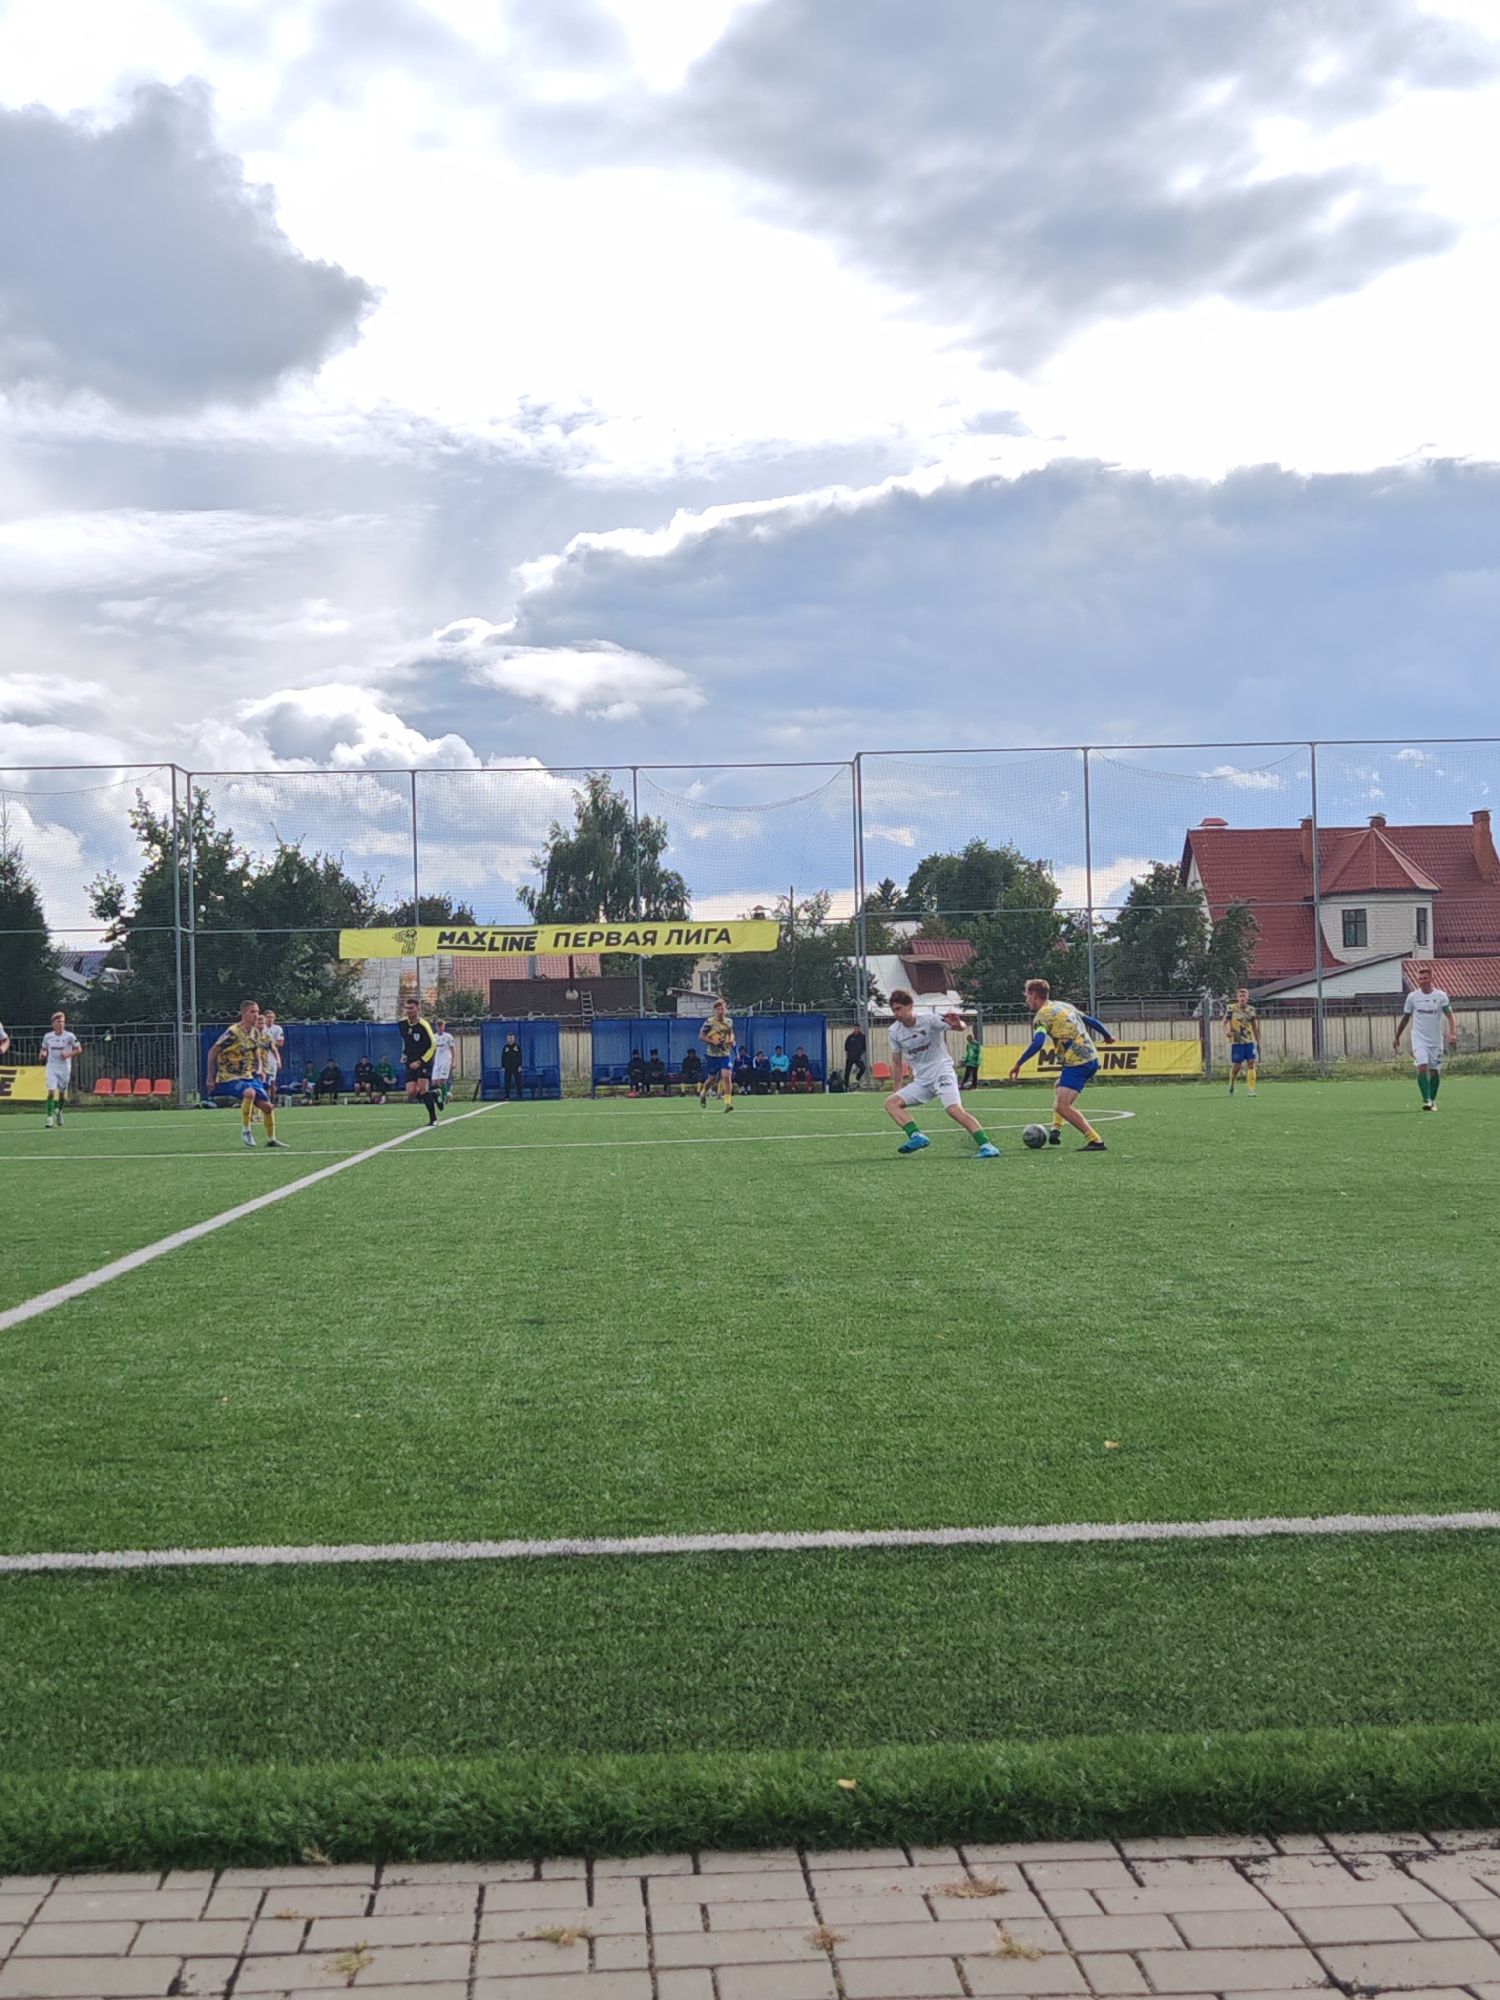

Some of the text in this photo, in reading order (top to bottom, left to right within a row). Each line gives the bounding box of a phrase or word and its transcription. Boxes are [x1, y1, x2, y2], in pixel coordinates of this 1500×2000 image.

[437, 927, 732, 952] MAXLINE ПЕРВАЯ ЛИГА
[1038, 1049, 1139, 1070] MINE
